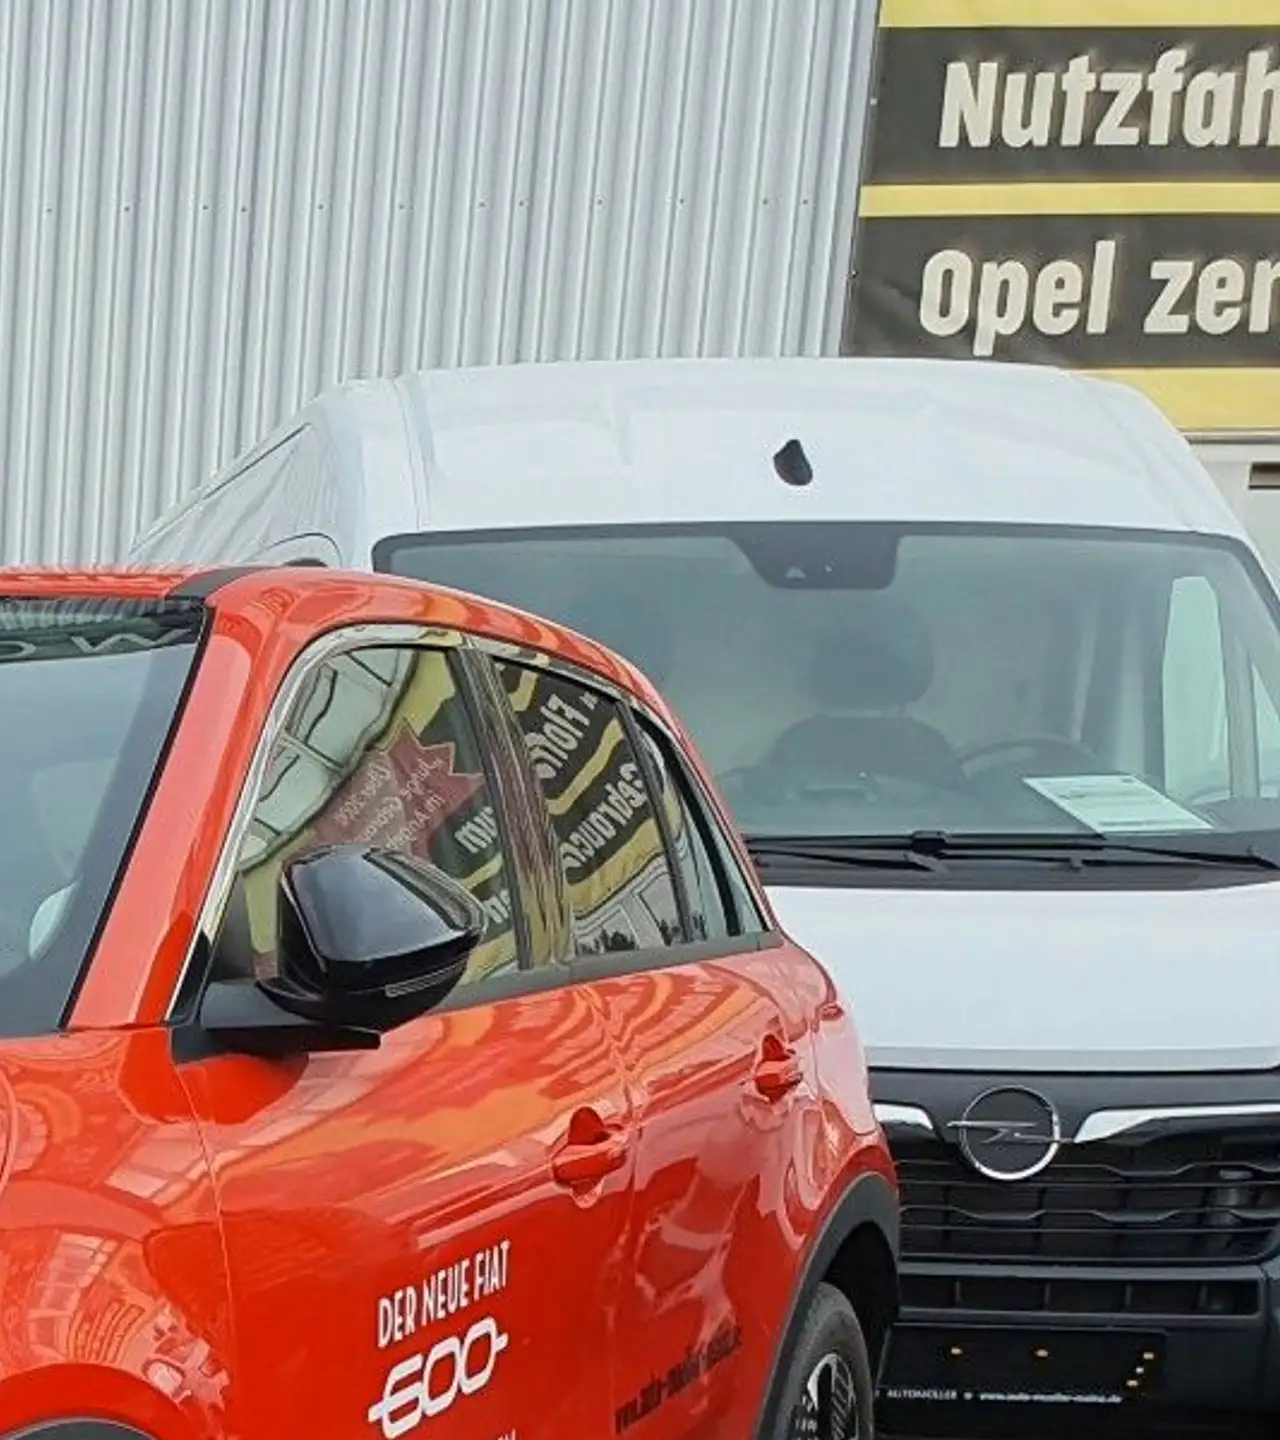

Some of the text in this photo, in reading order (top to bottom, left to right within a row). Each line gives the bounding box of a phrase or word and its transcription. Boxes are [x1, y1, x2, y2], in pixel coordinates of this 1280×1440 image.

[939, 49, 1280, 148] Nutzfah
[920, 240, 1116, 357] Opel
[378, 1239, 511, 1349] DER NEUE FIAT
[368, 1315, 509, 1440] 600
